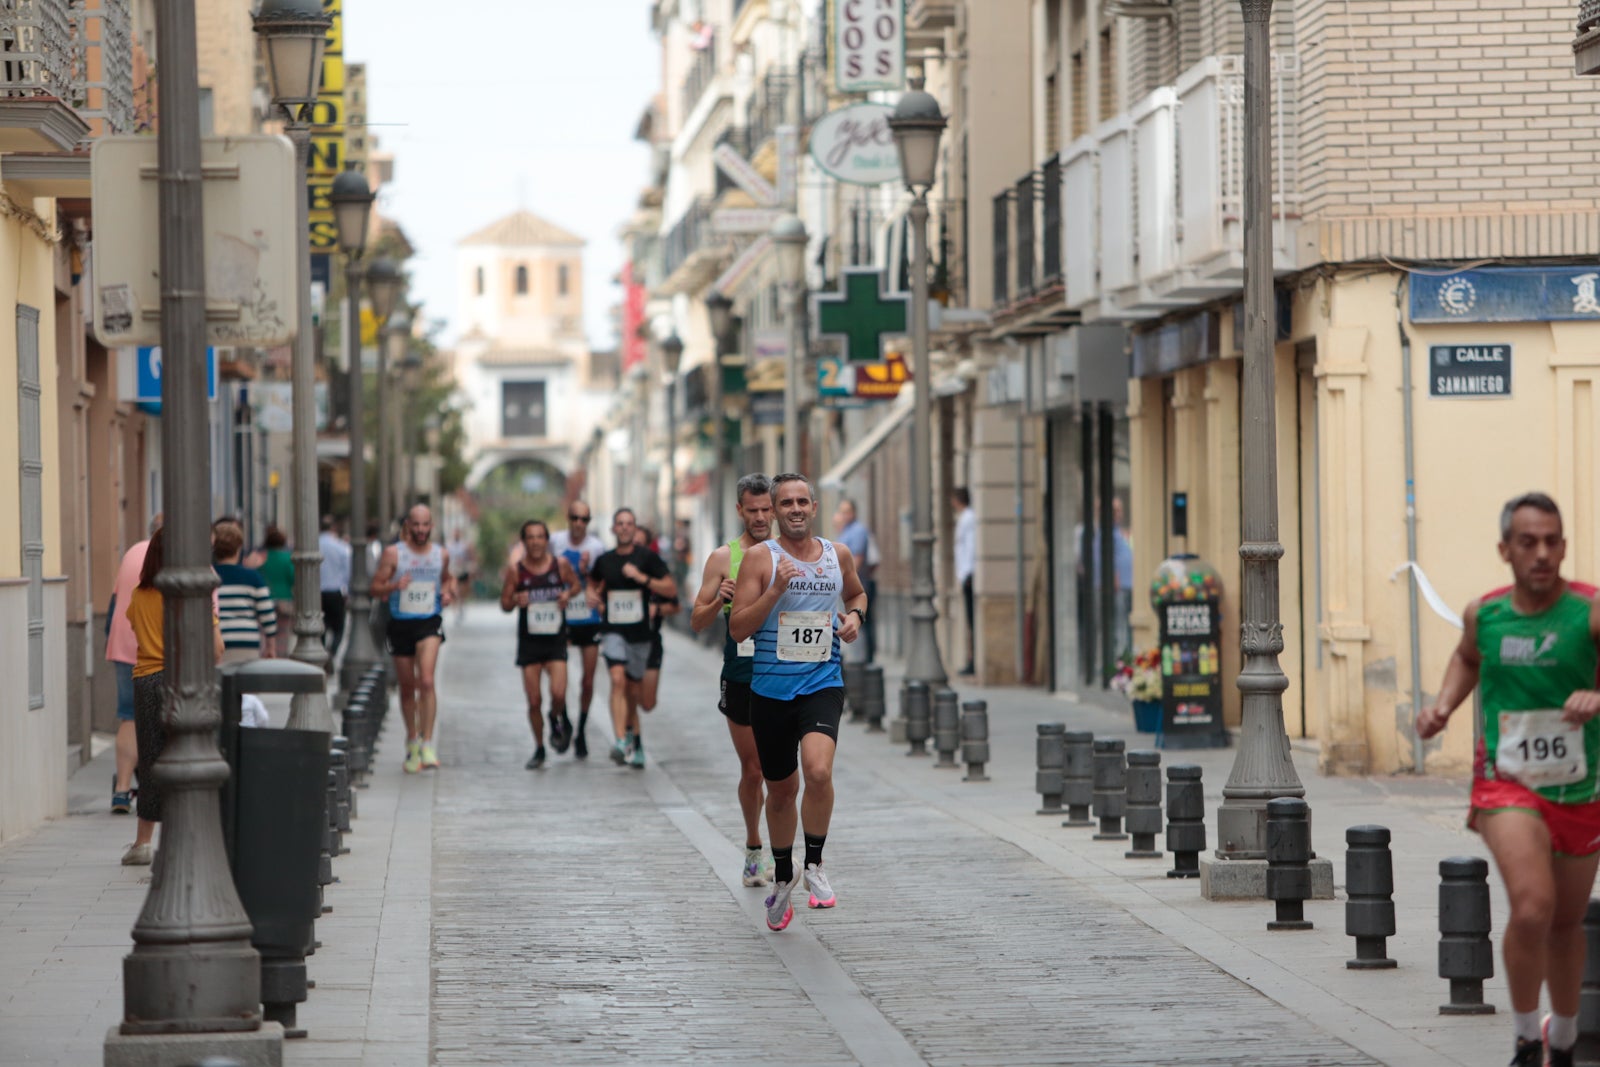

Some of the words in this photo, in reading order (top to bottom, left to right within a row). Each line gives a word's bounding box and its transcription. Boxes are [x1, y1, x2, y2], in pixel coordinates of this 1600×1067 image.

[1455, 347, 1504, 362] CALLE
[786, 581, 836, 592] MARACENA
[792, 628, 823, 644] 187
[1518, 736, 1567, 761] 196
